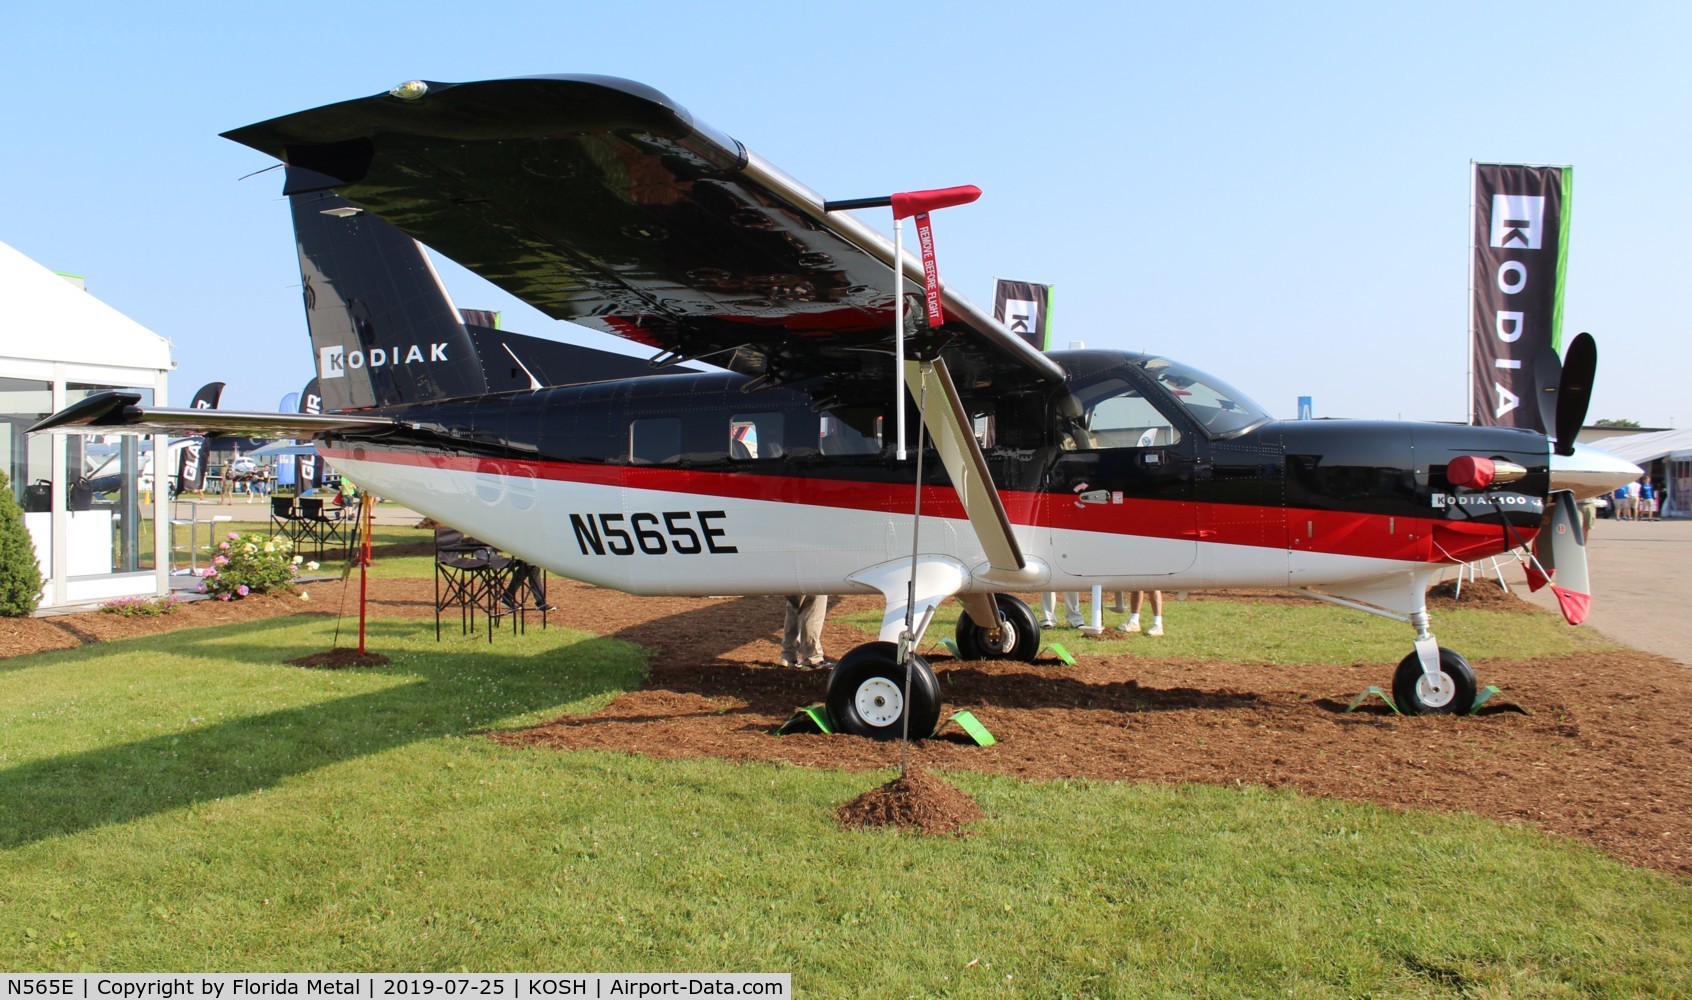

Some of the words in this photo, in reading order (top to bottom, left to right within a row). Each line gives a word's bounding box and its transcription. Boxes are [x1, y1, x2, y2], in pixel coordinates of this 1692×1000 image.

[919, 226, 932, 259] REMOVE
[925, 260, 936, 290] BEFORE
[928, 291, 939, 318] FLIGHT
[1495, 219, 1530, 418] KODIA
[329, 343, 448, 371] KODIAK
[1499, 496, 1527, 505] 100
[569, 511, 738, 556] N565E
